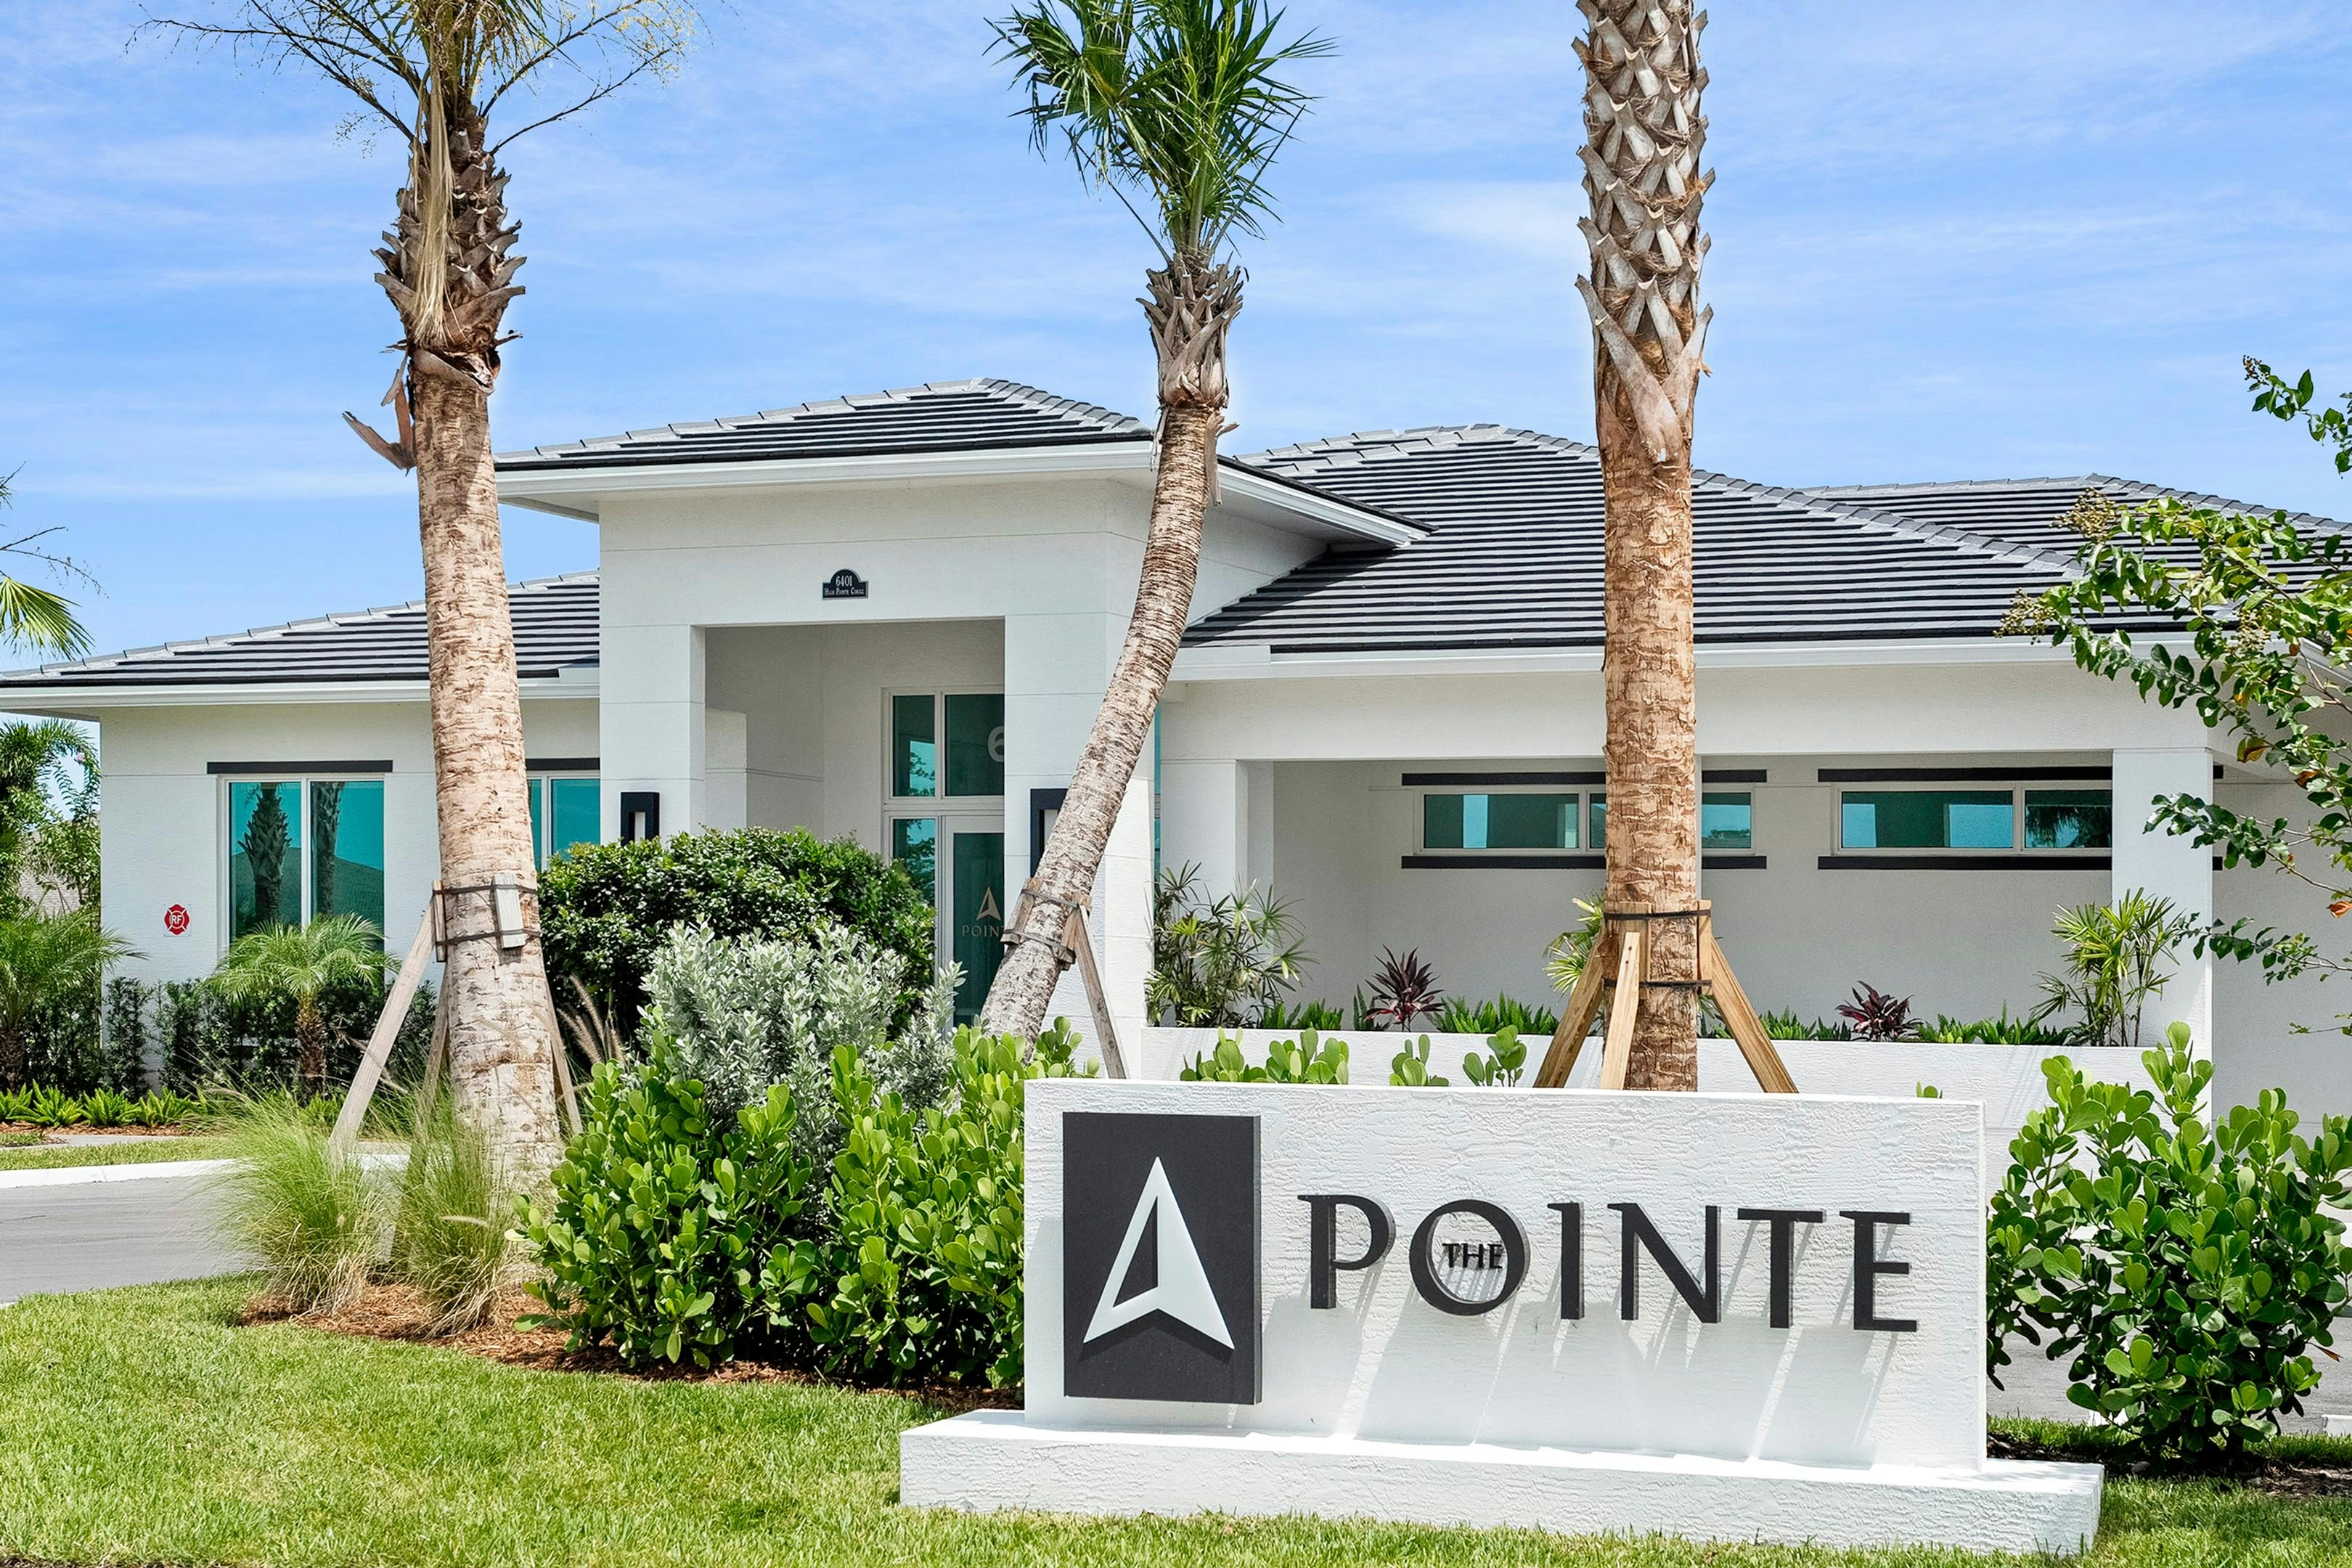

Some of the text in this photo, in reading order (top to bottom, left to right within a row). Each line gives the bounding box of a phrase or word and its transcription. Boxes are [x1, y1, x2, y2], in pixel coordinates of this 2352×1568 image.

[836, 575, 852, 587] 6401
[171, 915, 181, 924] RF
[962, 925, 1004, 937] POIN
[1442, 1242, 1503, 1269] THE
[1297, 1194, 1917, 1332] POINTE
